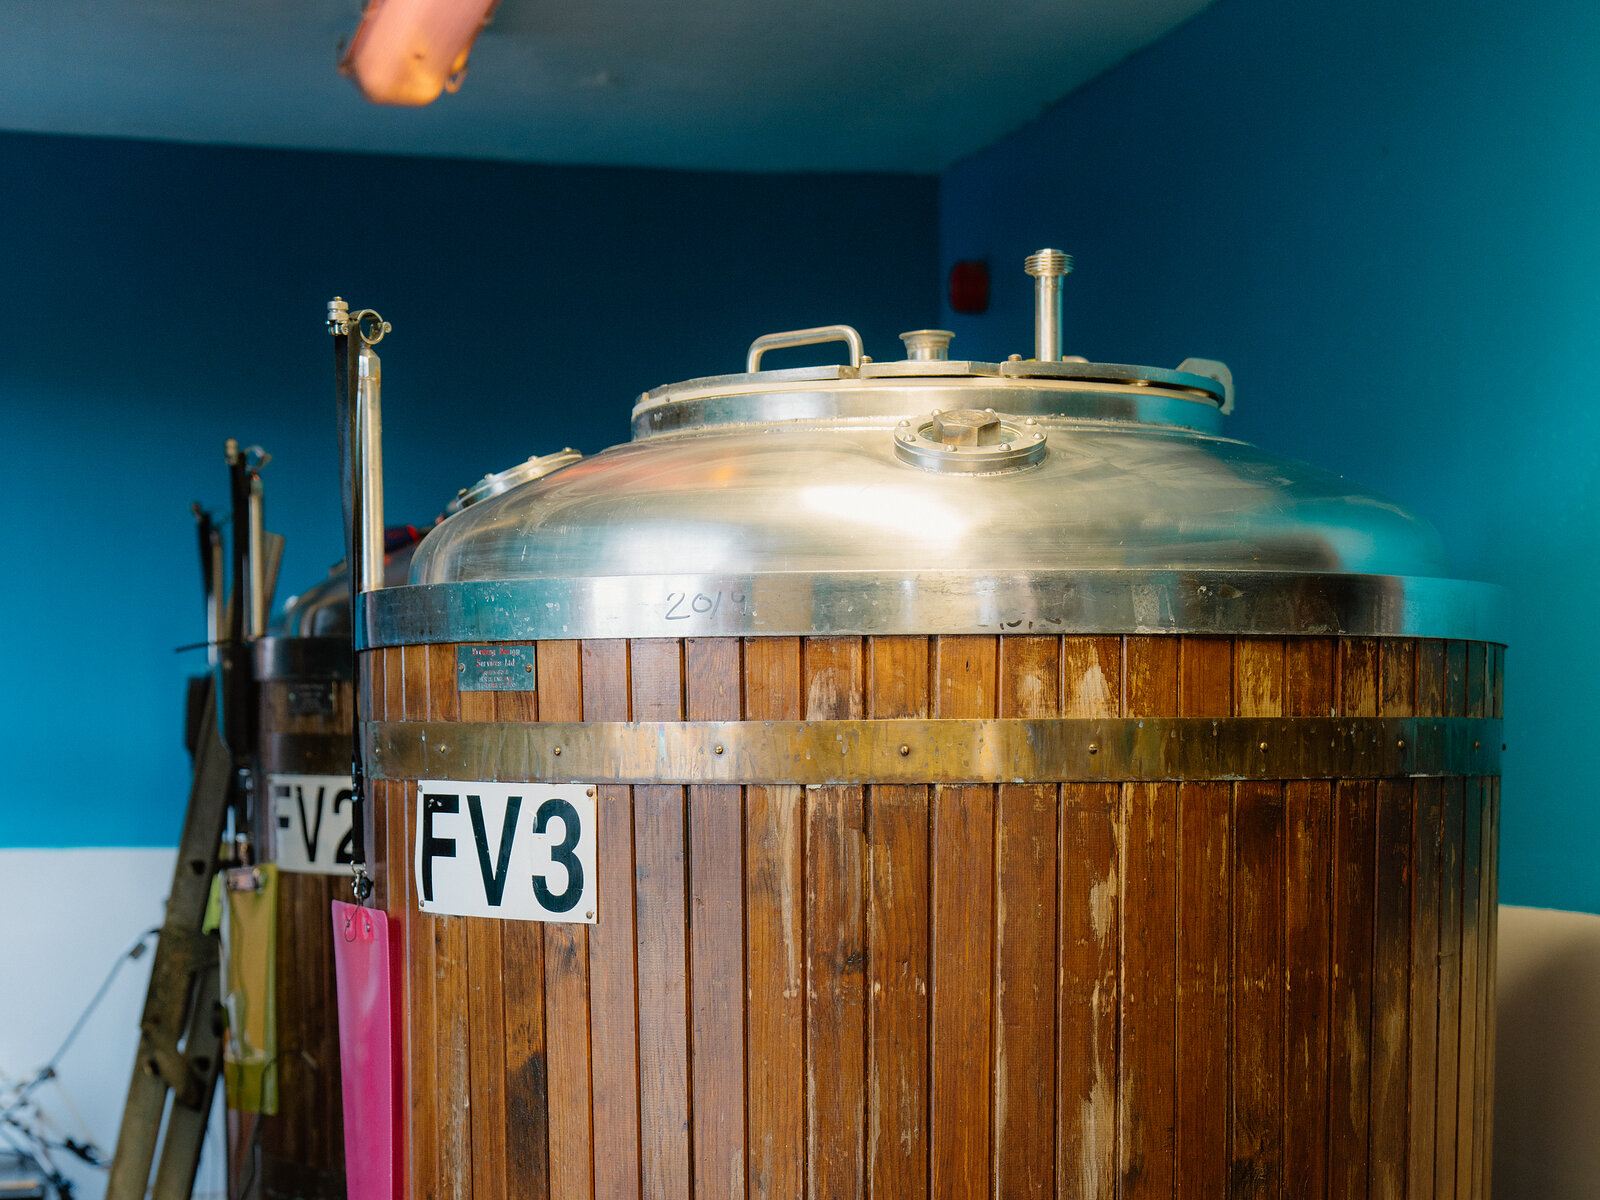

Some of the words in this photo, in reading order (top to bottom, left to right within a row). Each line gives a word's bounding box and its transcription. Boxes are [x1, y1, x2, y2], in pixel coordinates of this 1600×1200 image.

[472, 647, 496, 657] Brewing
[499, 646, 521, 657] Design
[476, 658, 502, 667] Services
[504, 658, 515, 666] Ltd
[422, 793, 584, 913] FV3
